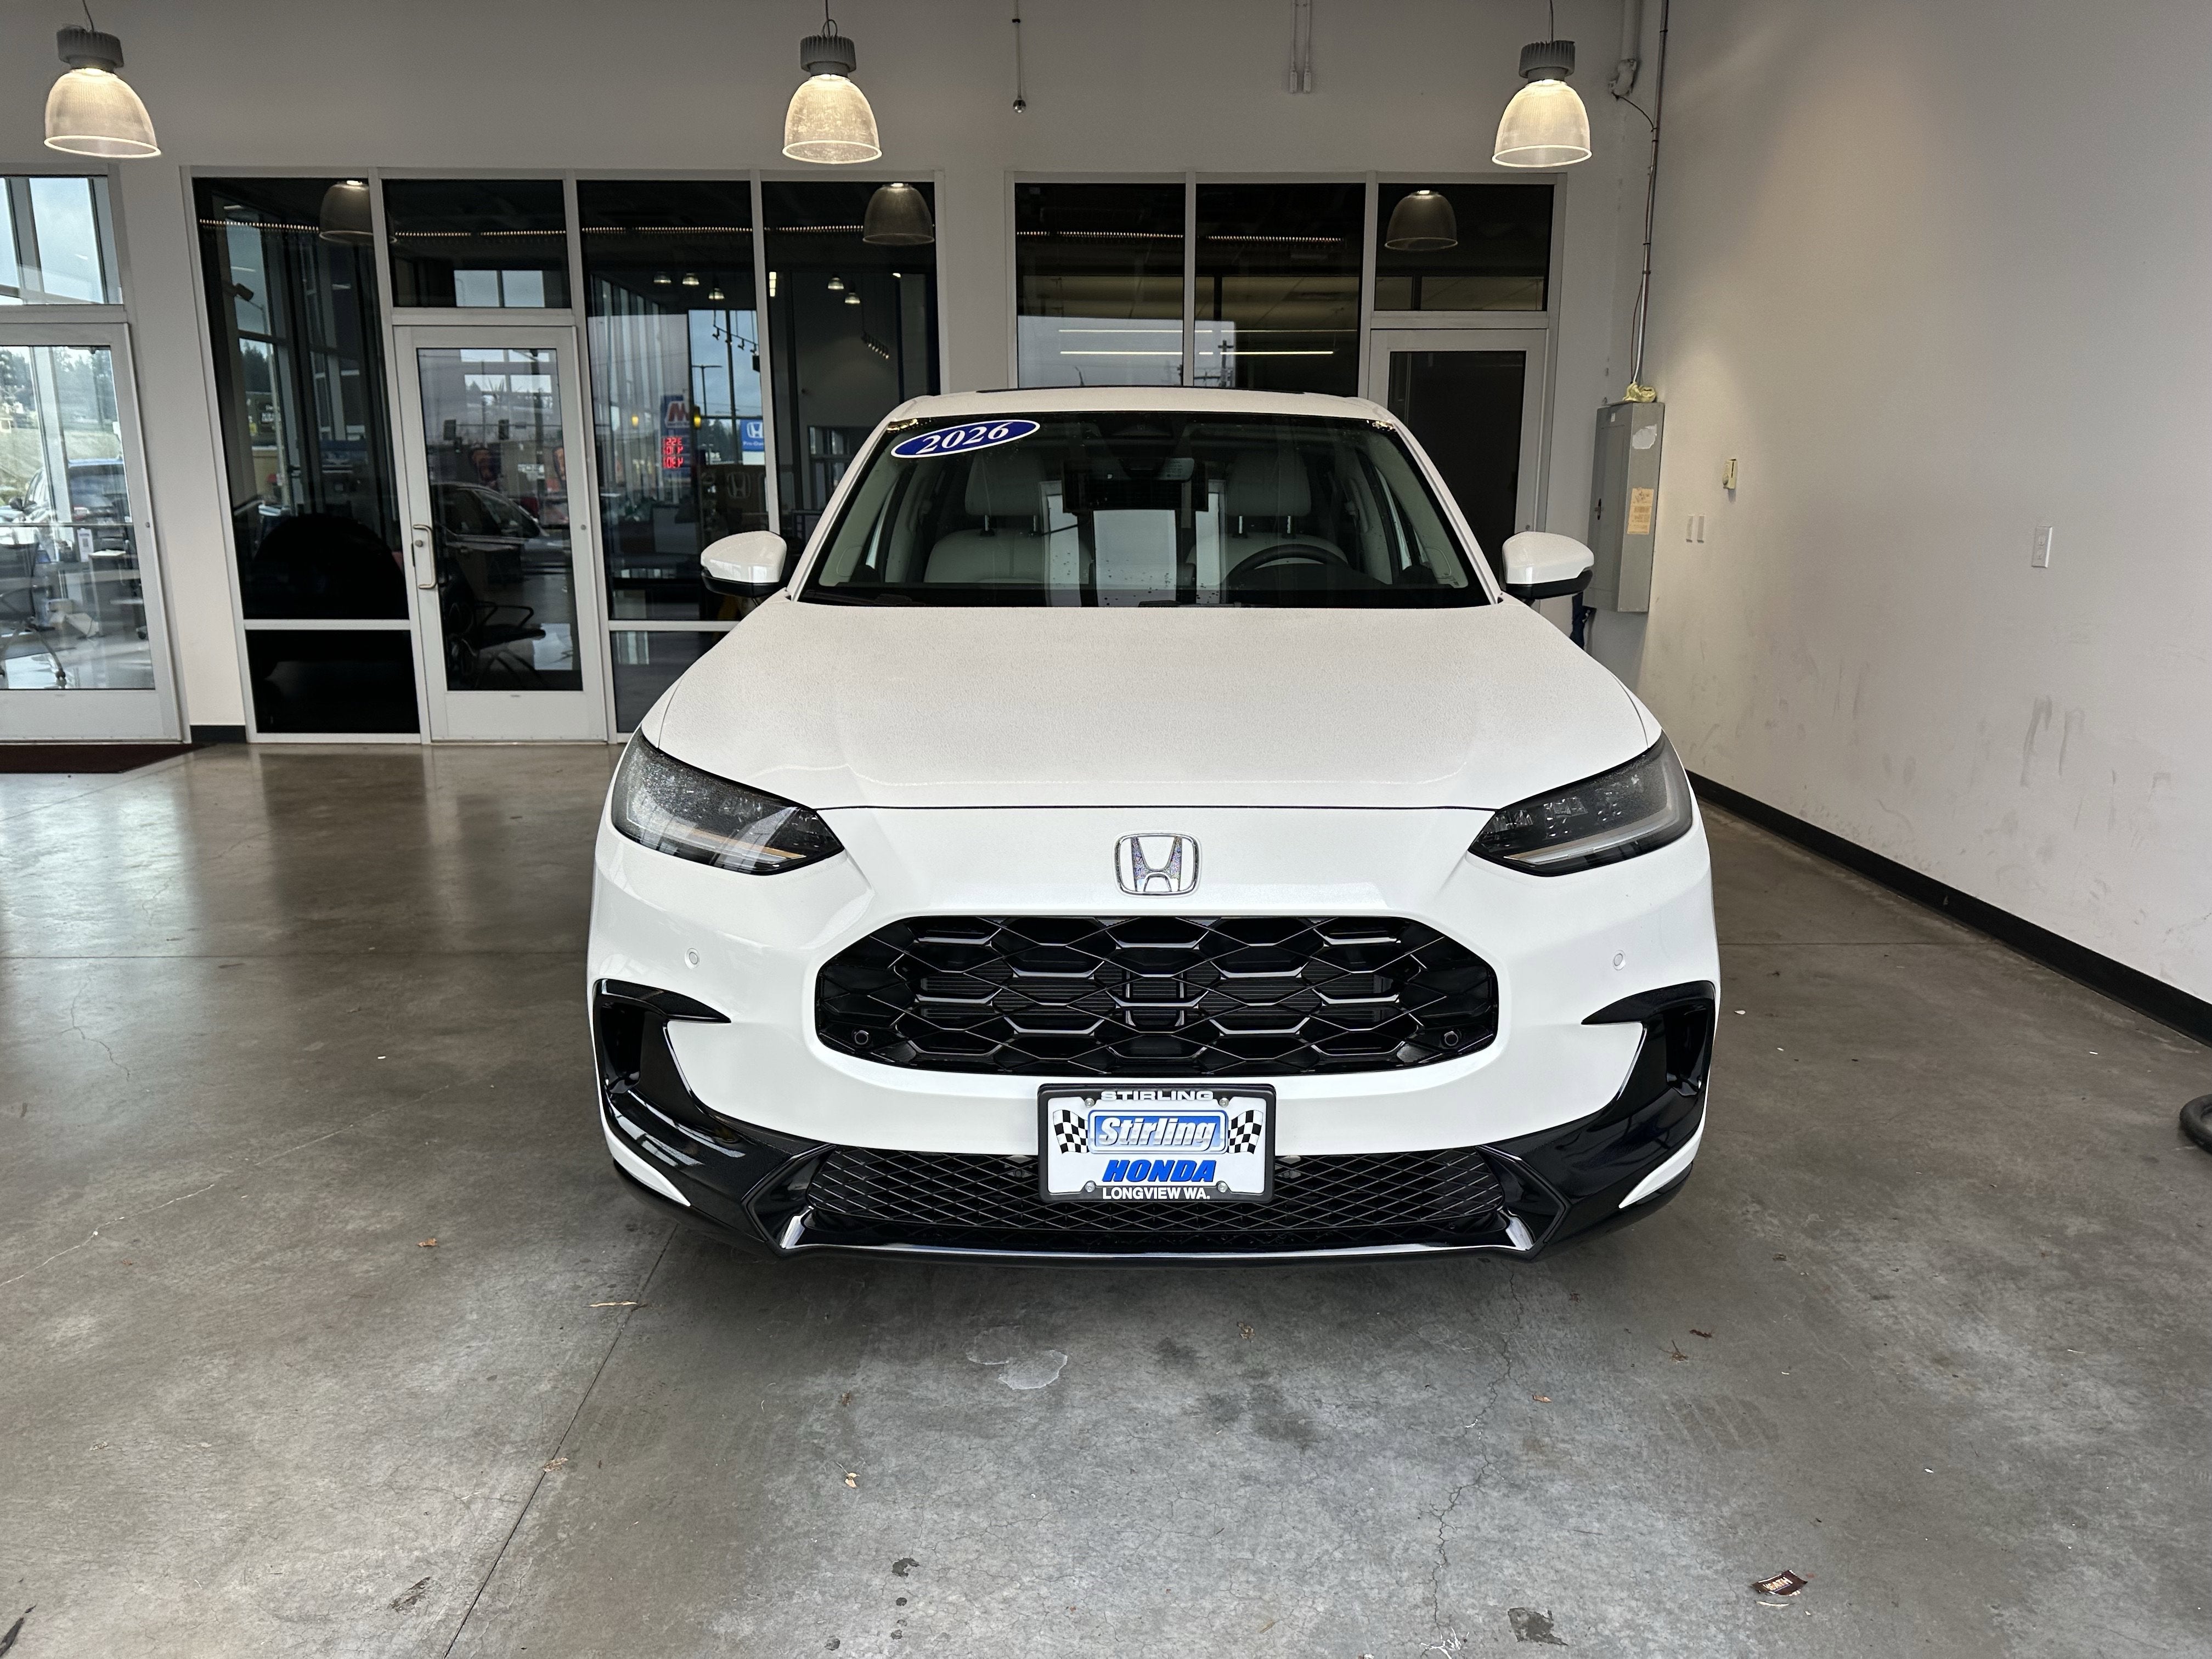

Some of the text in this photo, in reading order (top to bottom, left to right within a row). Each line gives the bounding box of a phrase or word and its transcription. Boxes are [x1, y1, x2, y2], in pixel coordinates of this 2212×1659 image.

[916, 422, 1014, 454] 2026
[1101, 1091, 1214, 1101] STIRLING
[1098, 1117, 1217, 1151] Stirling
[1102, 1160, 1217, 1182] HONDA
[1103, 1187, 1210, 1200] LONGVIEW WA.
